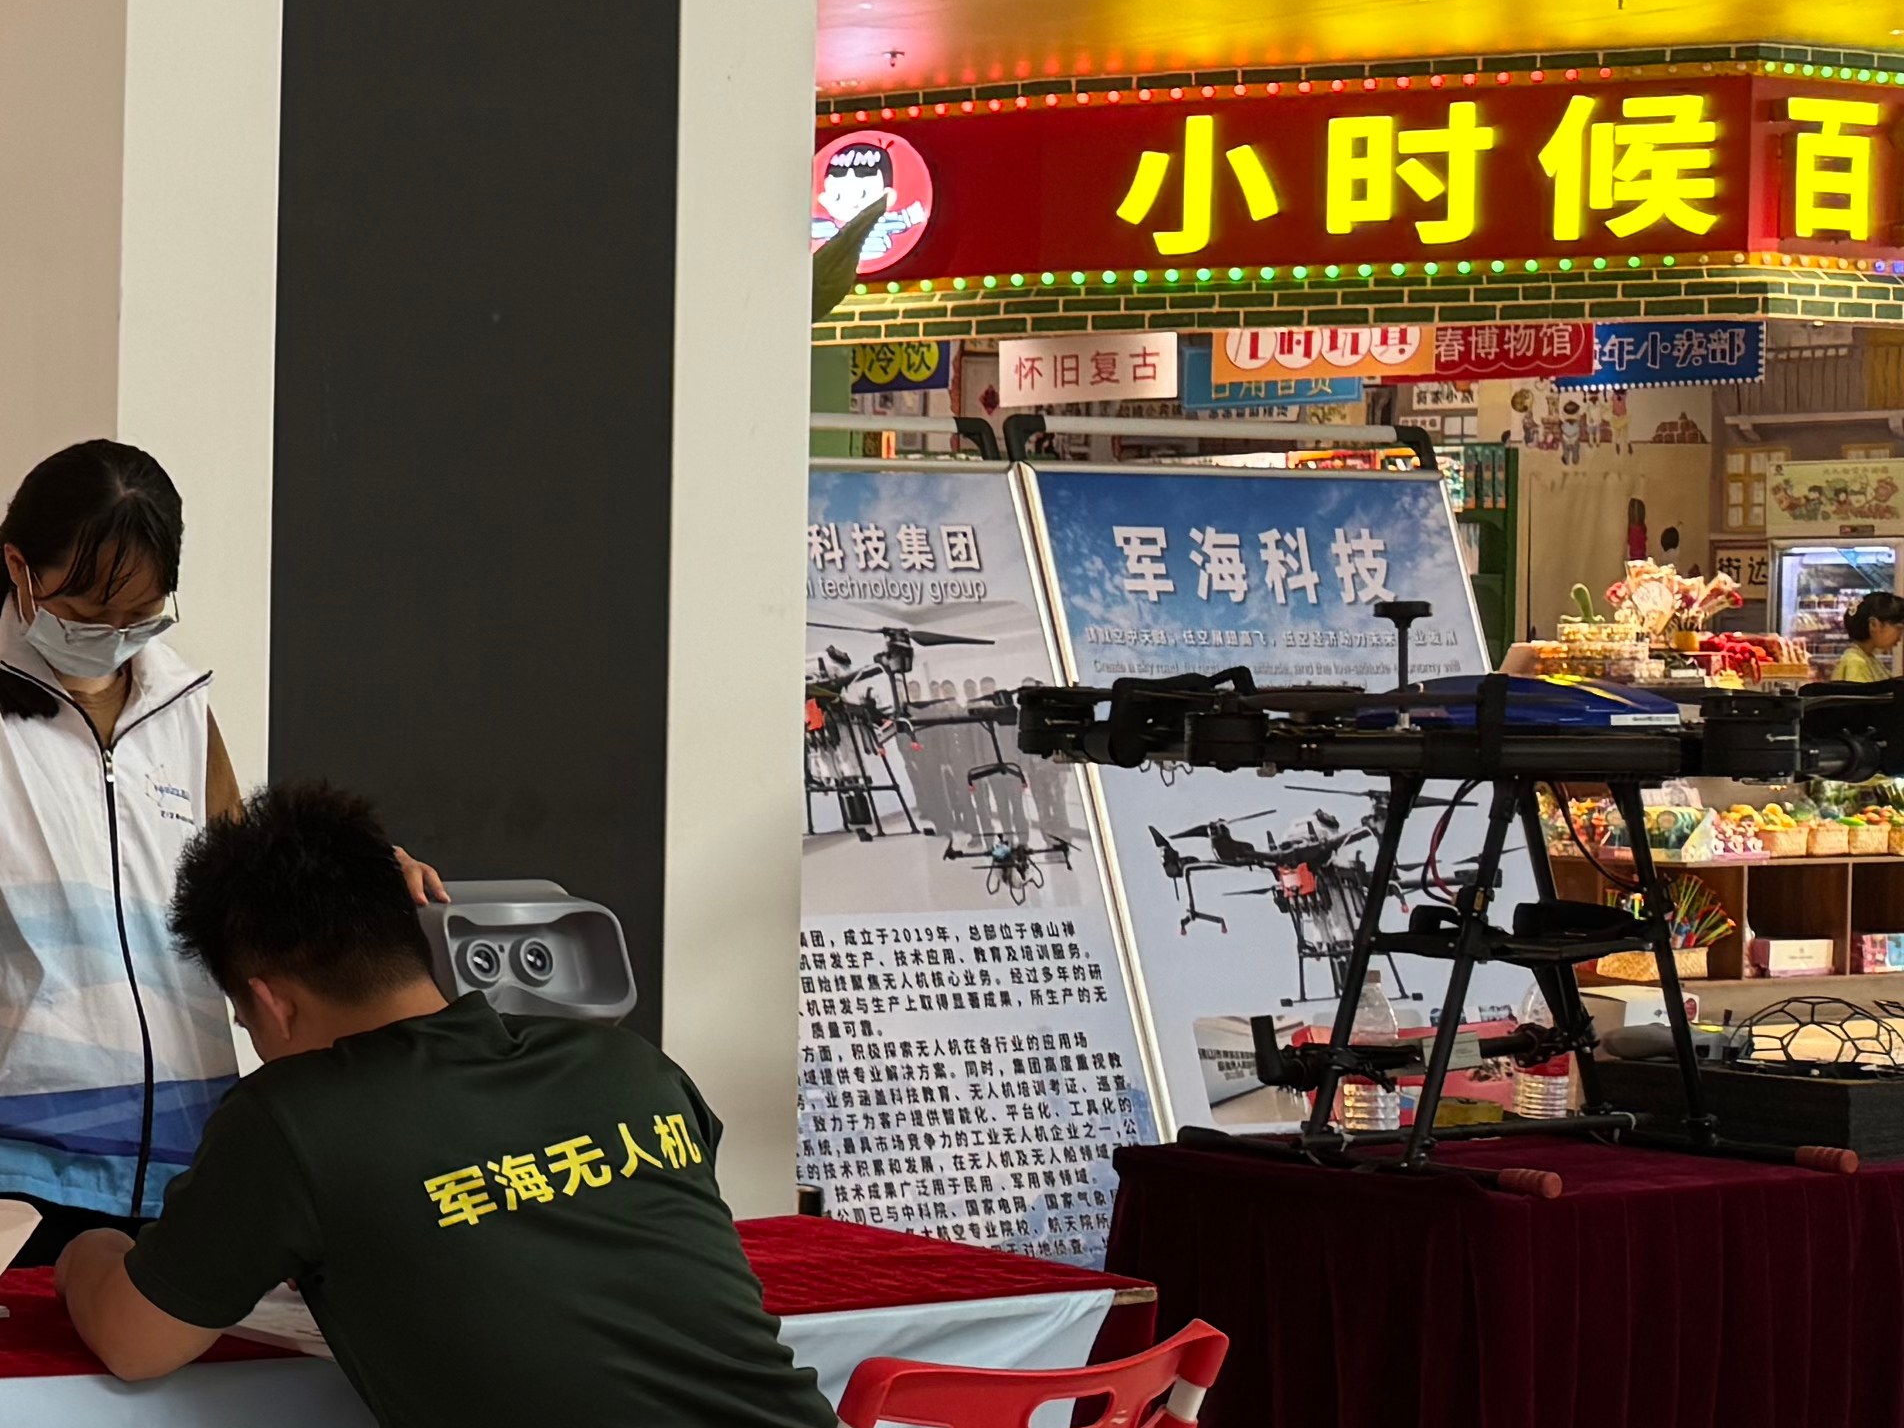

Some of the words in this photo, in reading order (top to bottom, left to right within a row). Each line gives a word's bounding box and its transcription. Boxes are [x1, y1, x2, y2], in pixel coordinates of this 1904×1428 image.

[1435, 322, 1573, 363] 春博物馆
[1013, 345, 1162, 392] 怀旧复古
[808, 522, 982, 571] 科技集团
[1112, 524, 1398, 605] 军海科技
[819, 575, 923, 606] technology
[928, 579, 988, 605] group
[799, 985, 1108, 1018] 机研发与生产上取得显著成果，所生产的无
[423, 1113, 703, 1228] 军海无人机
